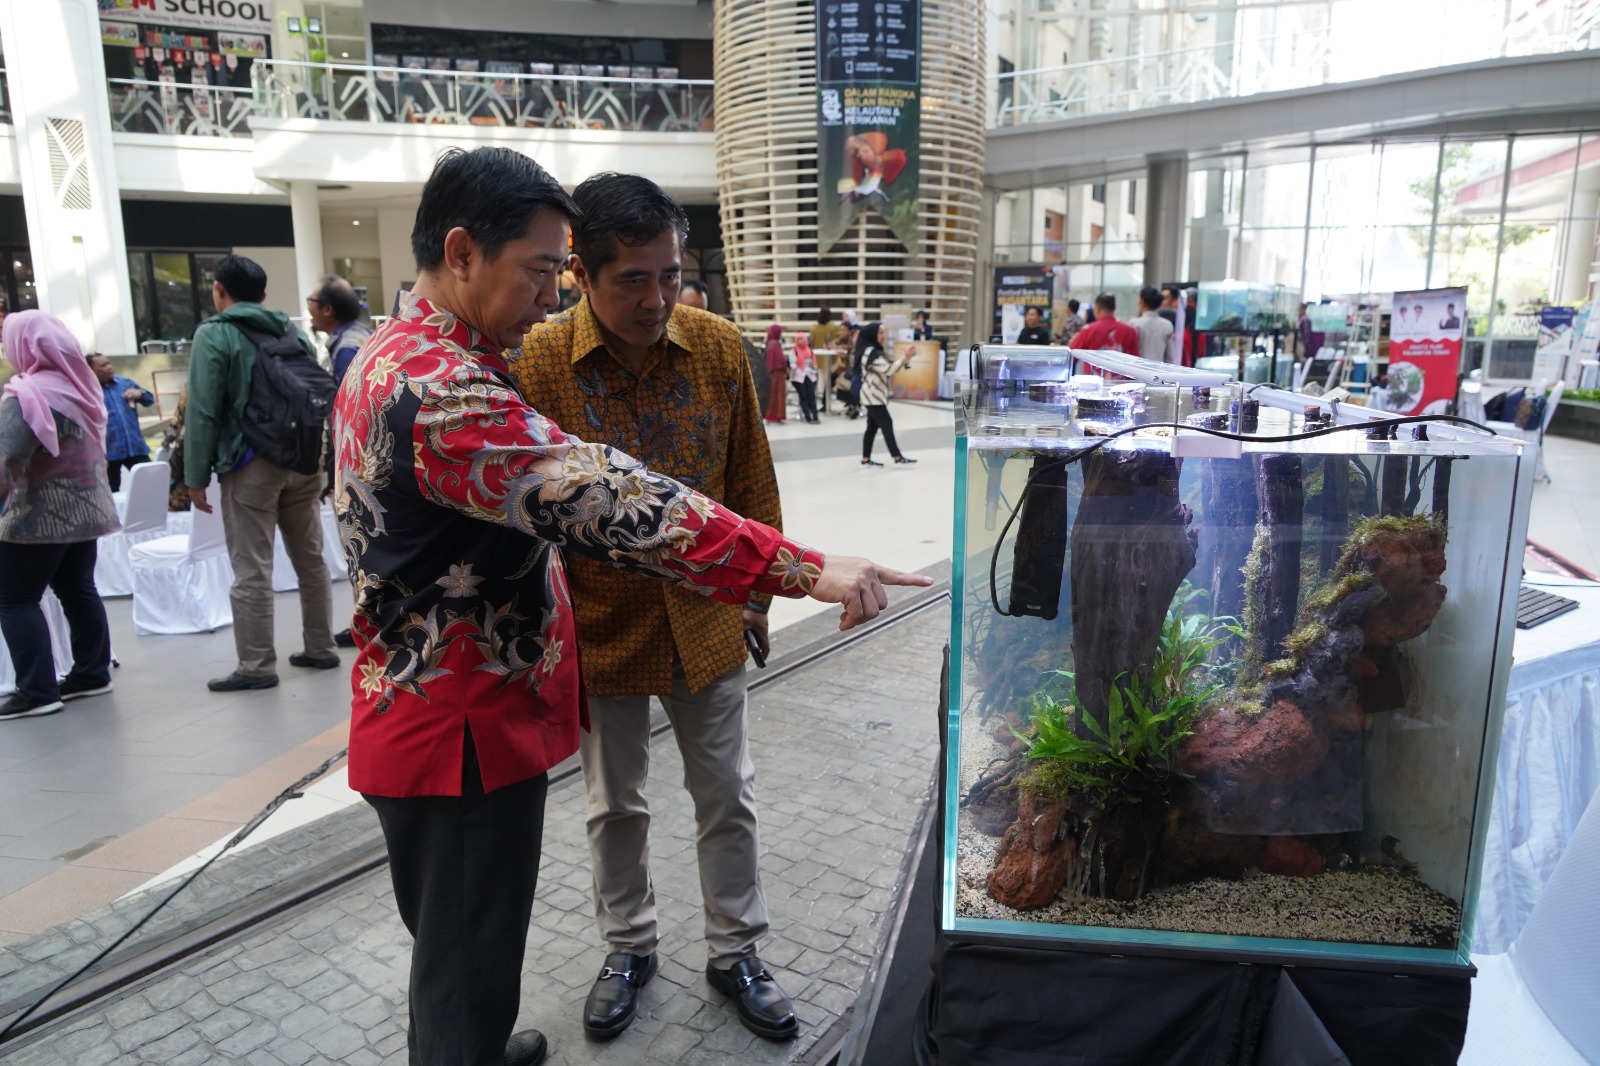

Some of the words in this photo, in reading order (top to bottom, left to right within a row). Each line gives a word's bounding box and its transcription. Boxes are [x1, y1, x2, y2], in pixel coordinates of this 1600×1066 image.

[164, 0, 271, 21] SCHOOL
[844, 87, 877, 98] DALAM
[844, 97, 876, 106] BULAN
[844, 106, 892, 116] KELAUTAN
[893, 107, 900, 117] &
[844, 116, 896, 126] PERIKANAN
